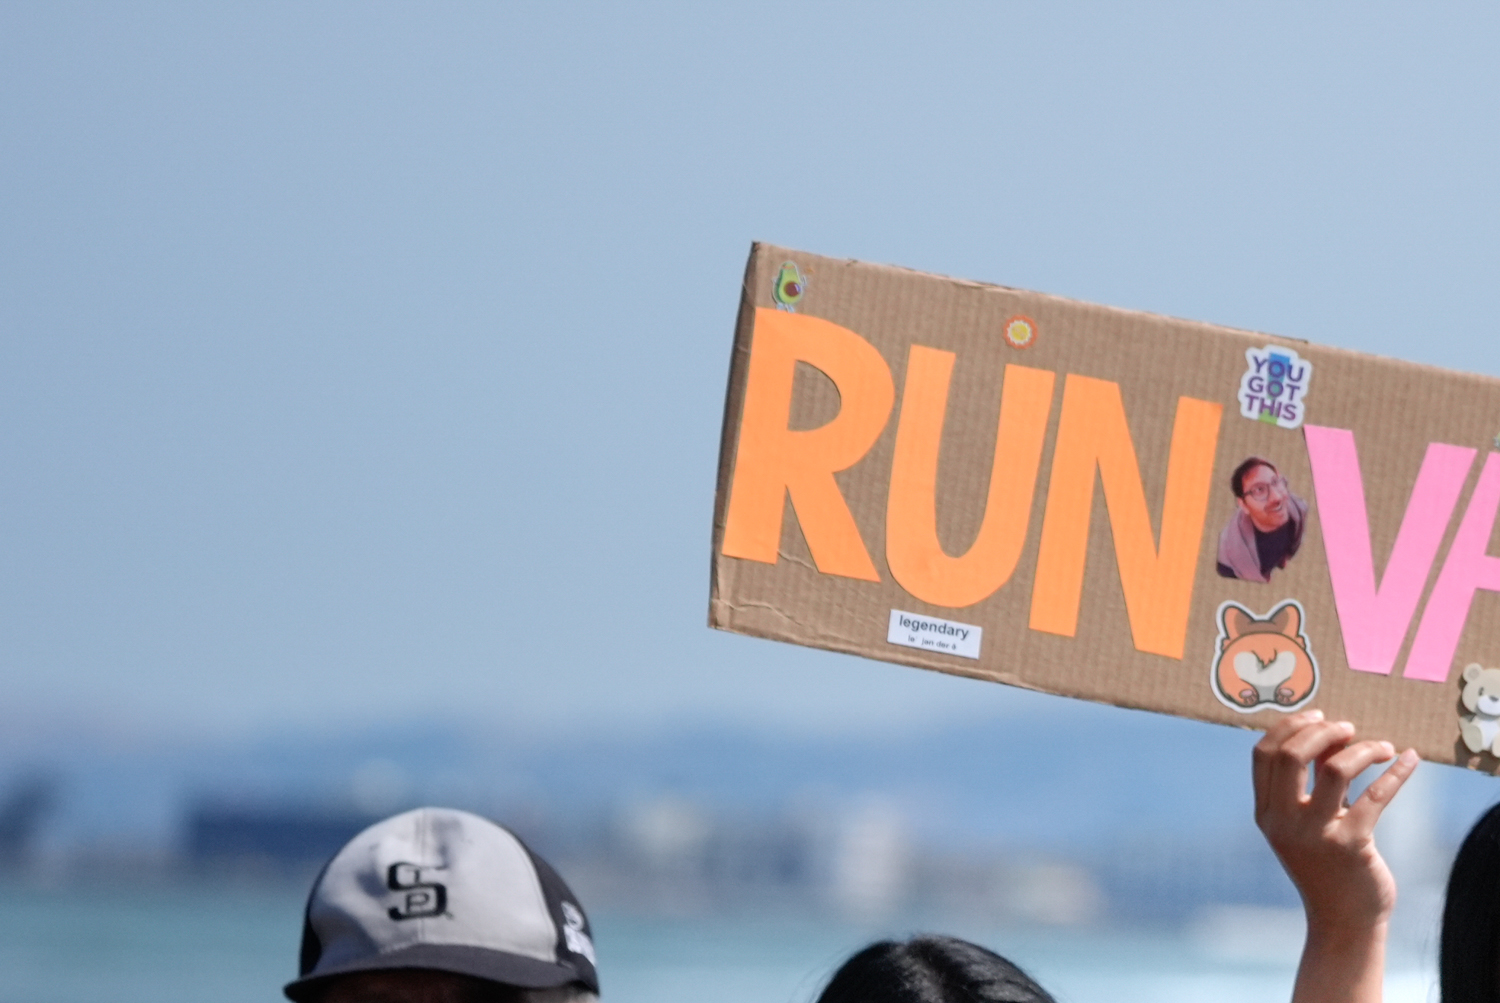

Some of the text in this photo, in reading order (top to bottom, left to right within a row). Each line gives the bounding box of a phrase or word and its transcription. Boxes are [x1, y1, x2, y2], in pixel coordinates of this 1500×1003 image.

[1251, 355, 1305, 383] YOU
[1247, 375, 1301, 401] GOT
[1244, 393, 1298, 421] THIS
[721, 306, 1223, 660] RUN
[898, 614, 970, 641] legendary
